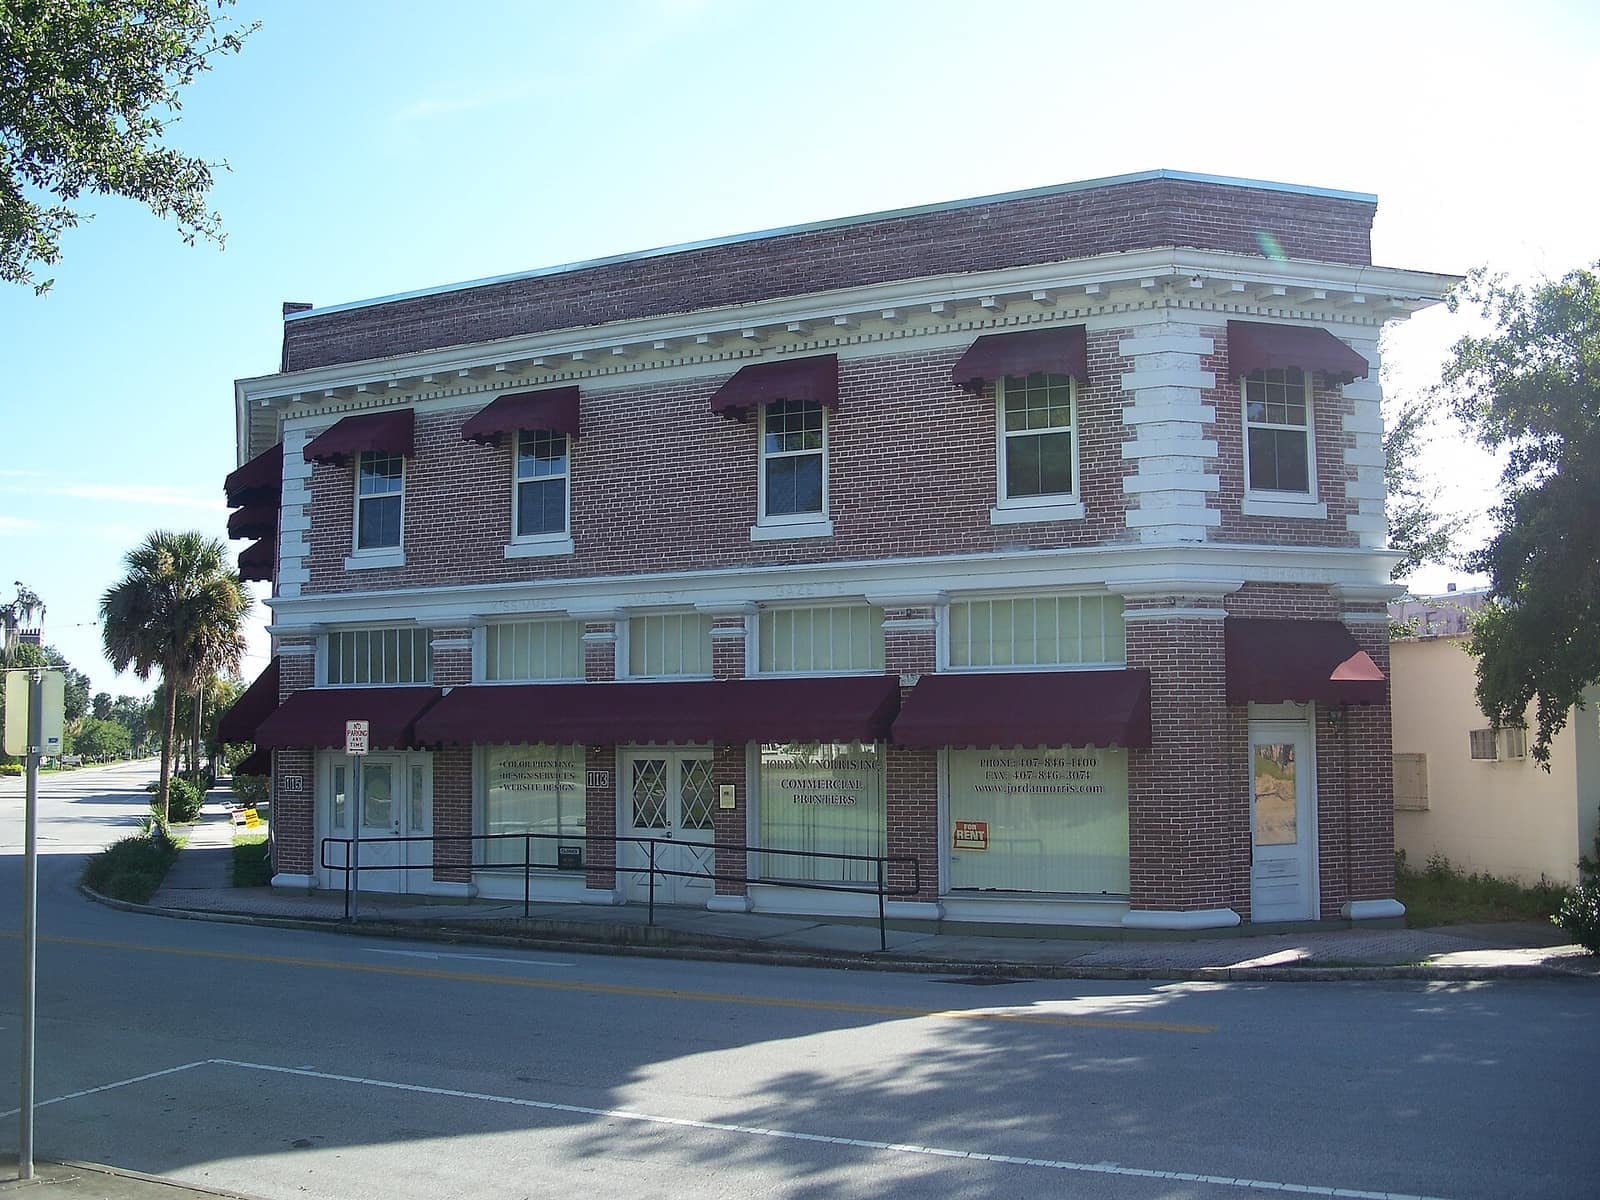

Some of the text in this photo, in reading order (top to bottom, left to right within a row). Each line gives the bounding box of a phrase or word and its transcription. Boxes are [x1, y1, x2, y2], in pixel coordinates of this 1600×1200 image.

[503, 760, 574, 769] COLOR PRINTING
[766, 759, 807, 769] JORDAN
[815, 759, 857, 770] NORRIS
[502, 771, 576, 780] DESIGN SERVICES
[588, 772, 607, 786] 113
[286, 778, 302, 790] 115
[503, 783, 576, 791] WEBSITE DESIGN
[781, 780, 863, 790] COMMERCIAL
[974, 783, 1104, 795] www.jordannorris.com
[793, 794, 856, 805] PRINTERS
[956, 830, 985, 841] RENT
